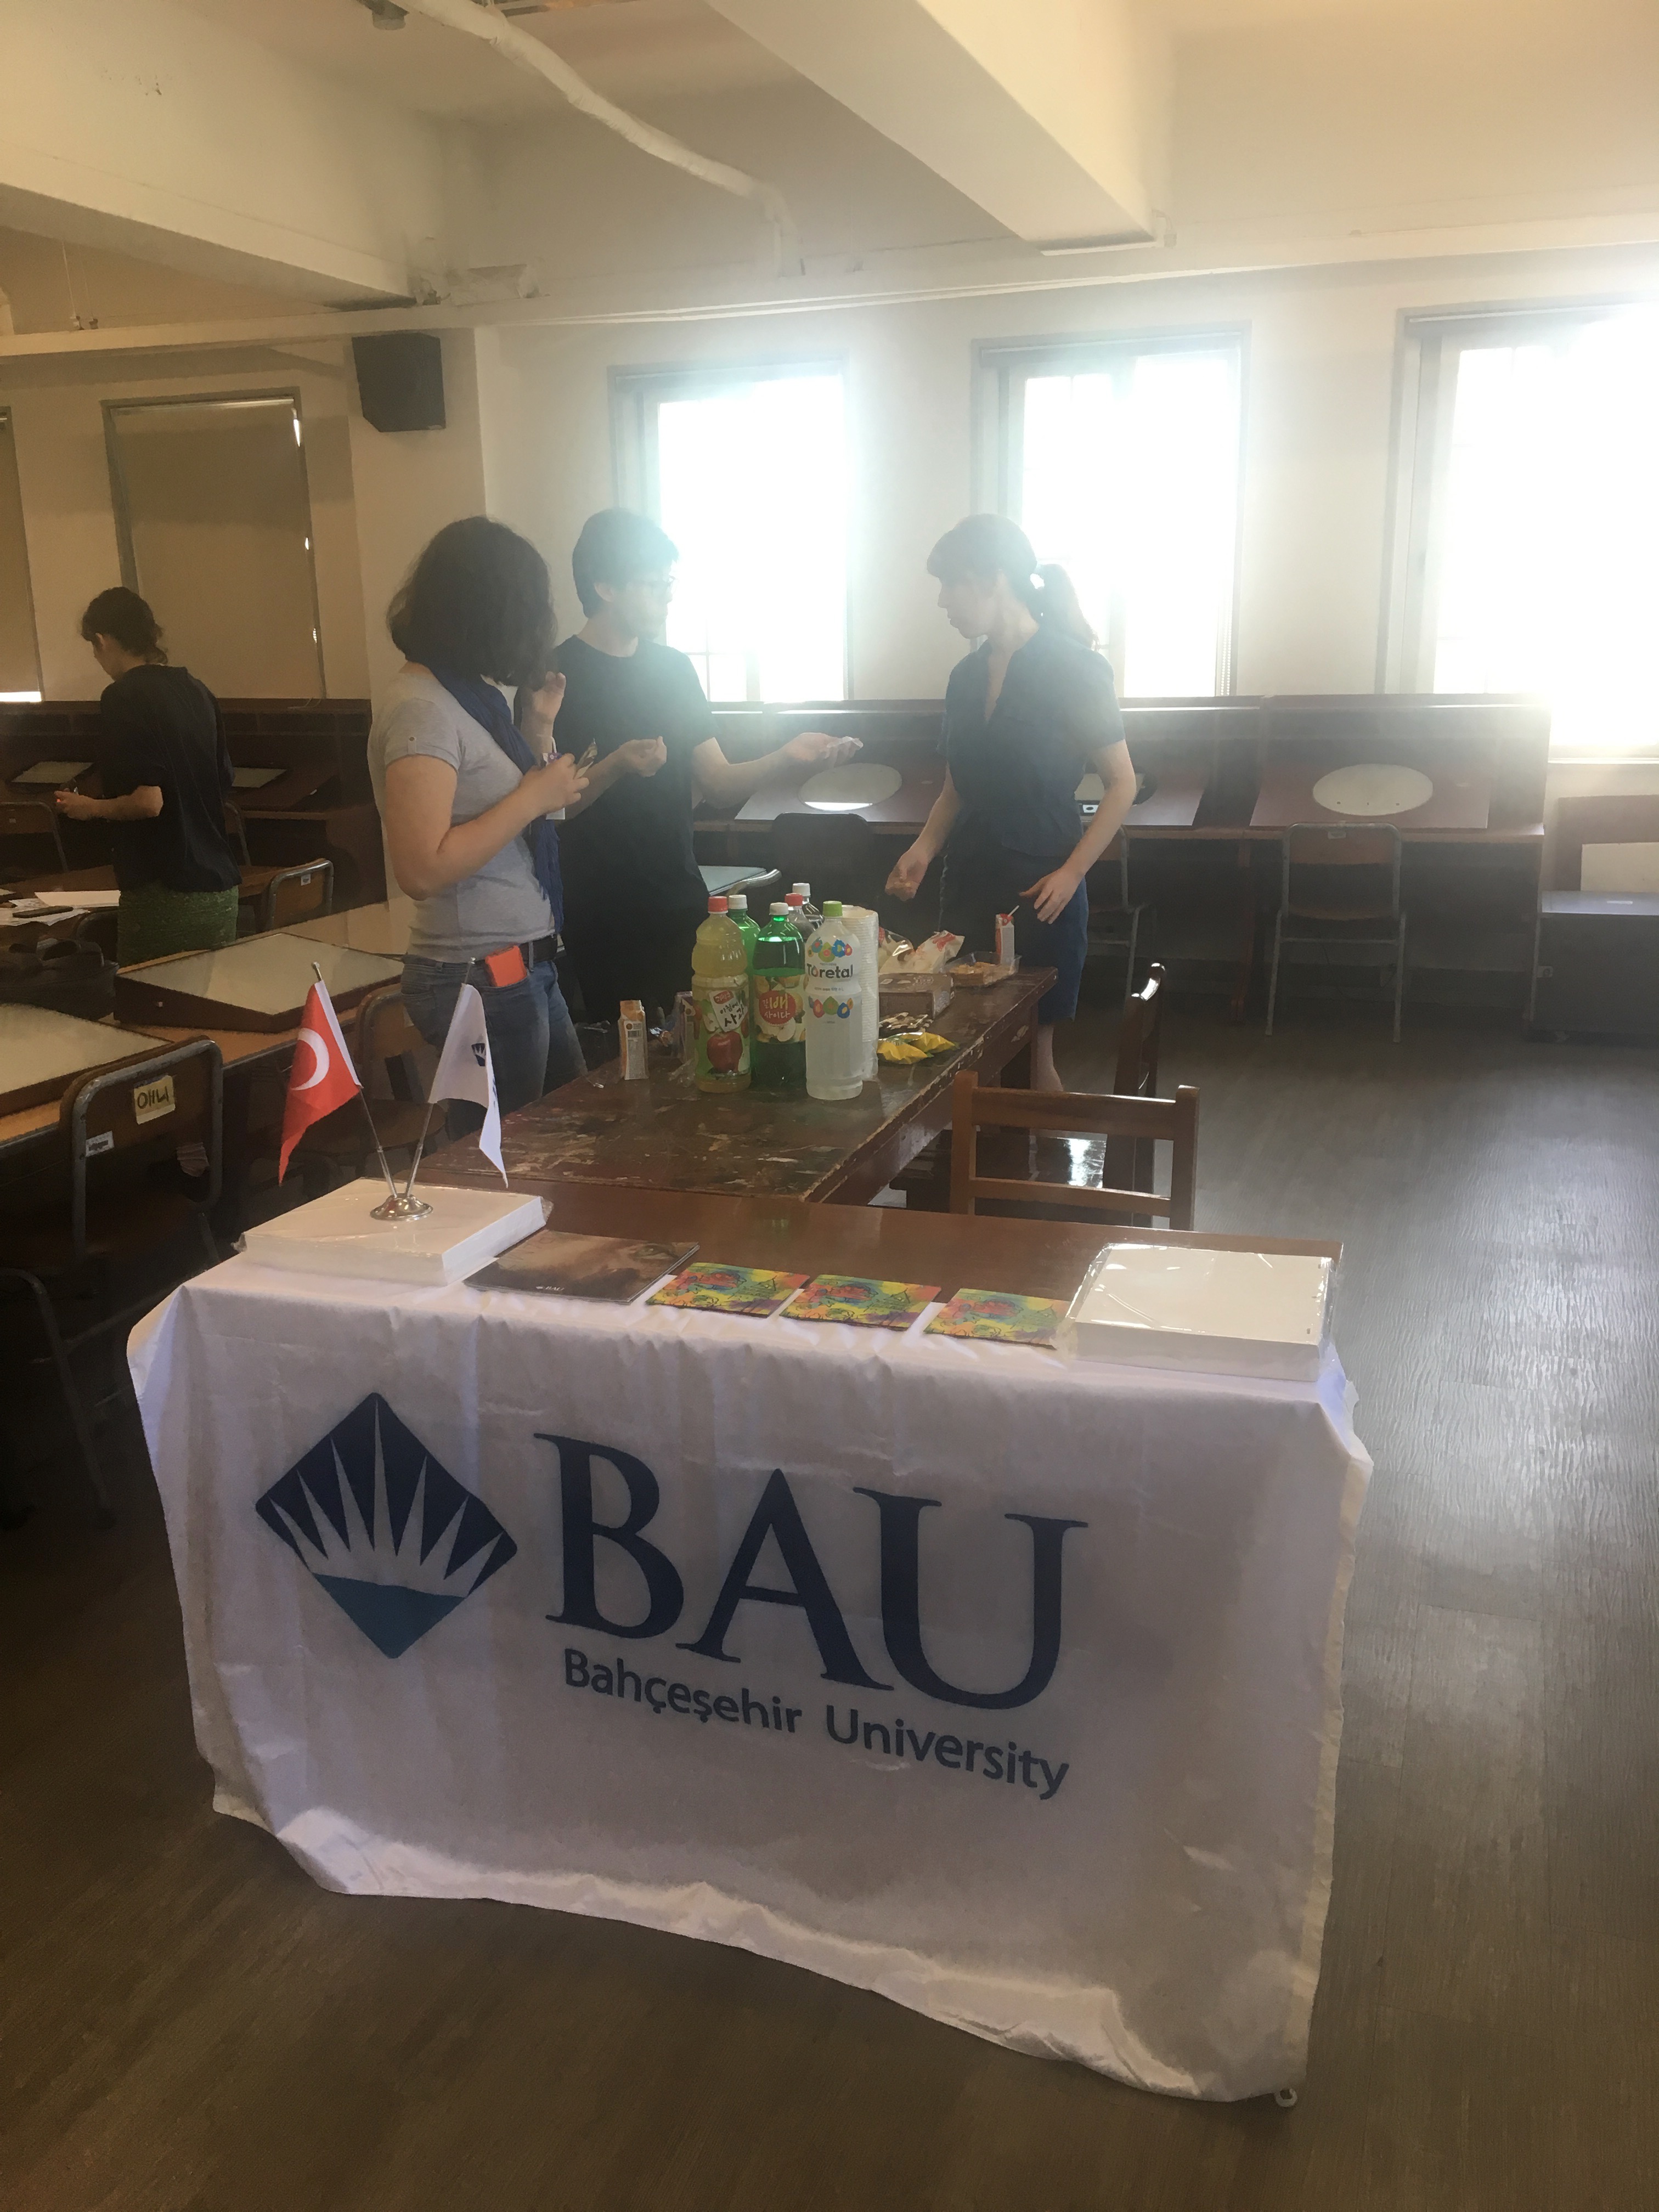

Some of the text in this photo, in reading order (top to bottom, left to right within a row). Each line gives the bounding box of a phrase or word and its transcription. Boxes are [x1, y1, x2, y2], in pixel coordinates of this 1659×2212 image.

[720, 1001, 739, 1014] 아침에
[724, 1003, 744, 1028] 사과
[764, 1010, 791, 1019] 사이다
[534, 1433, 1088, 1710] BAU
[564, 1647, 1070, 1800] Bahçeşehir University
